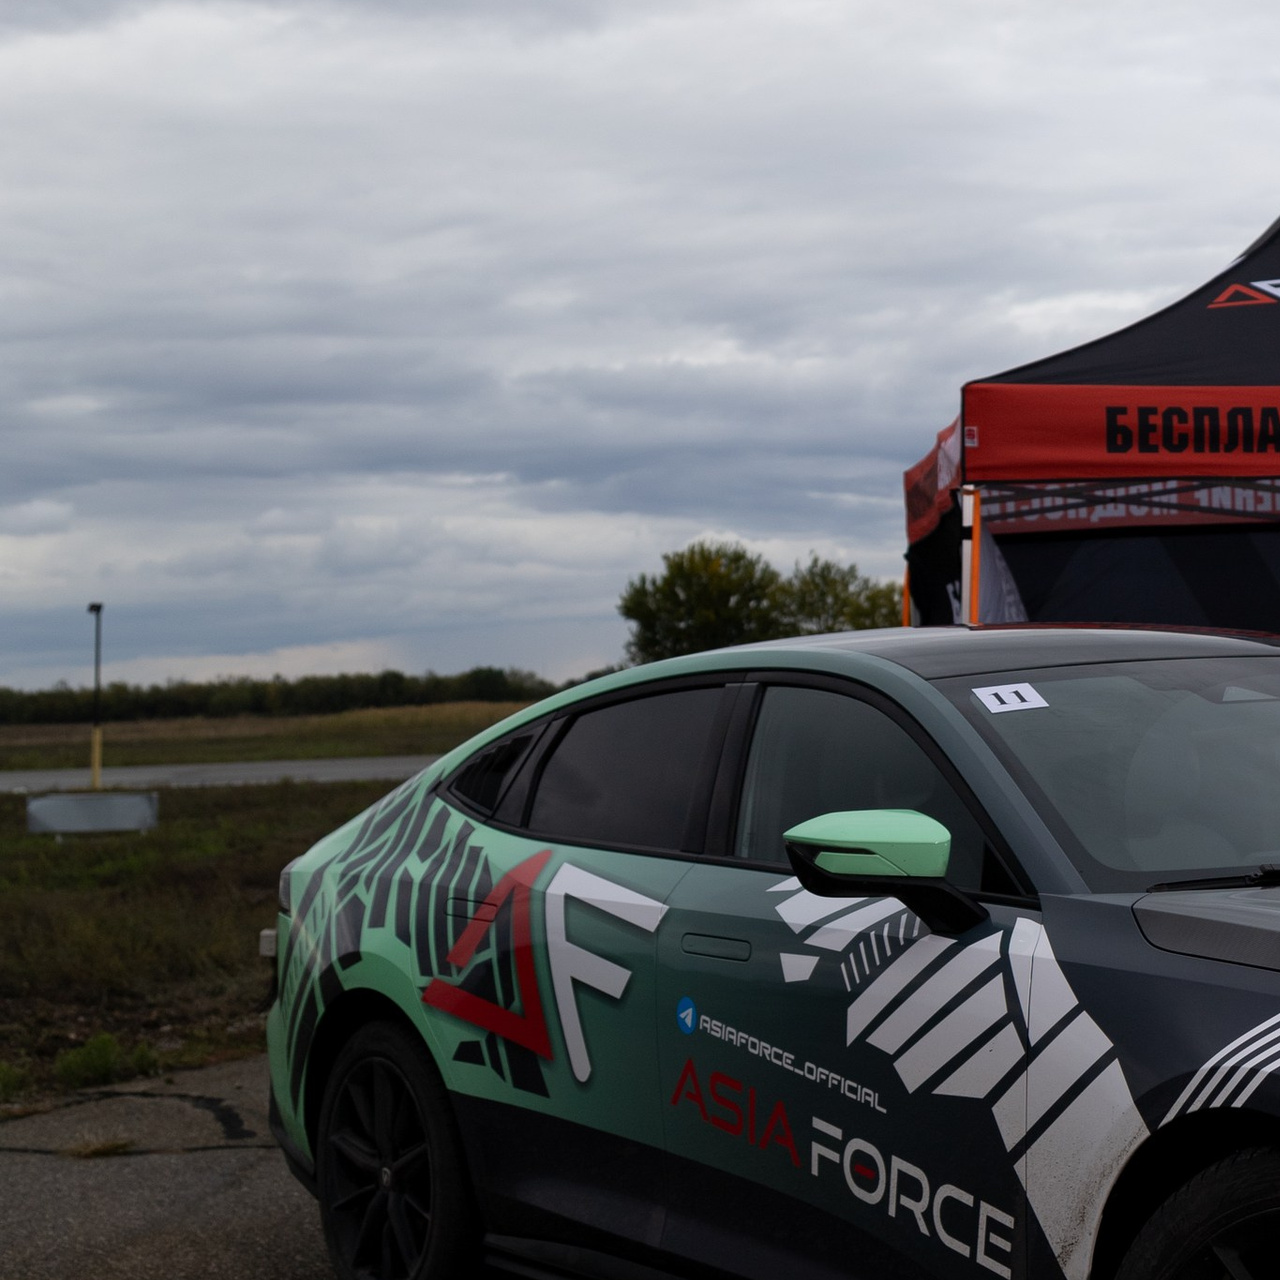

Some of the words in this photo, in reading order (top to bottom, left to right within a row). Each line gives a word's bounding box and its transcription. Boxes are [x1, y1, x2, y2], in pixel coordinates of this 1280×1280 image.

[989, 690, 1031, 706] 11
[699, 1014, 888, 1115] ASIAFORCE_OFFICIAL
[670, 1057, 802, 1169] ASIA
[810, 1116, 1016, 1280] FORCE
